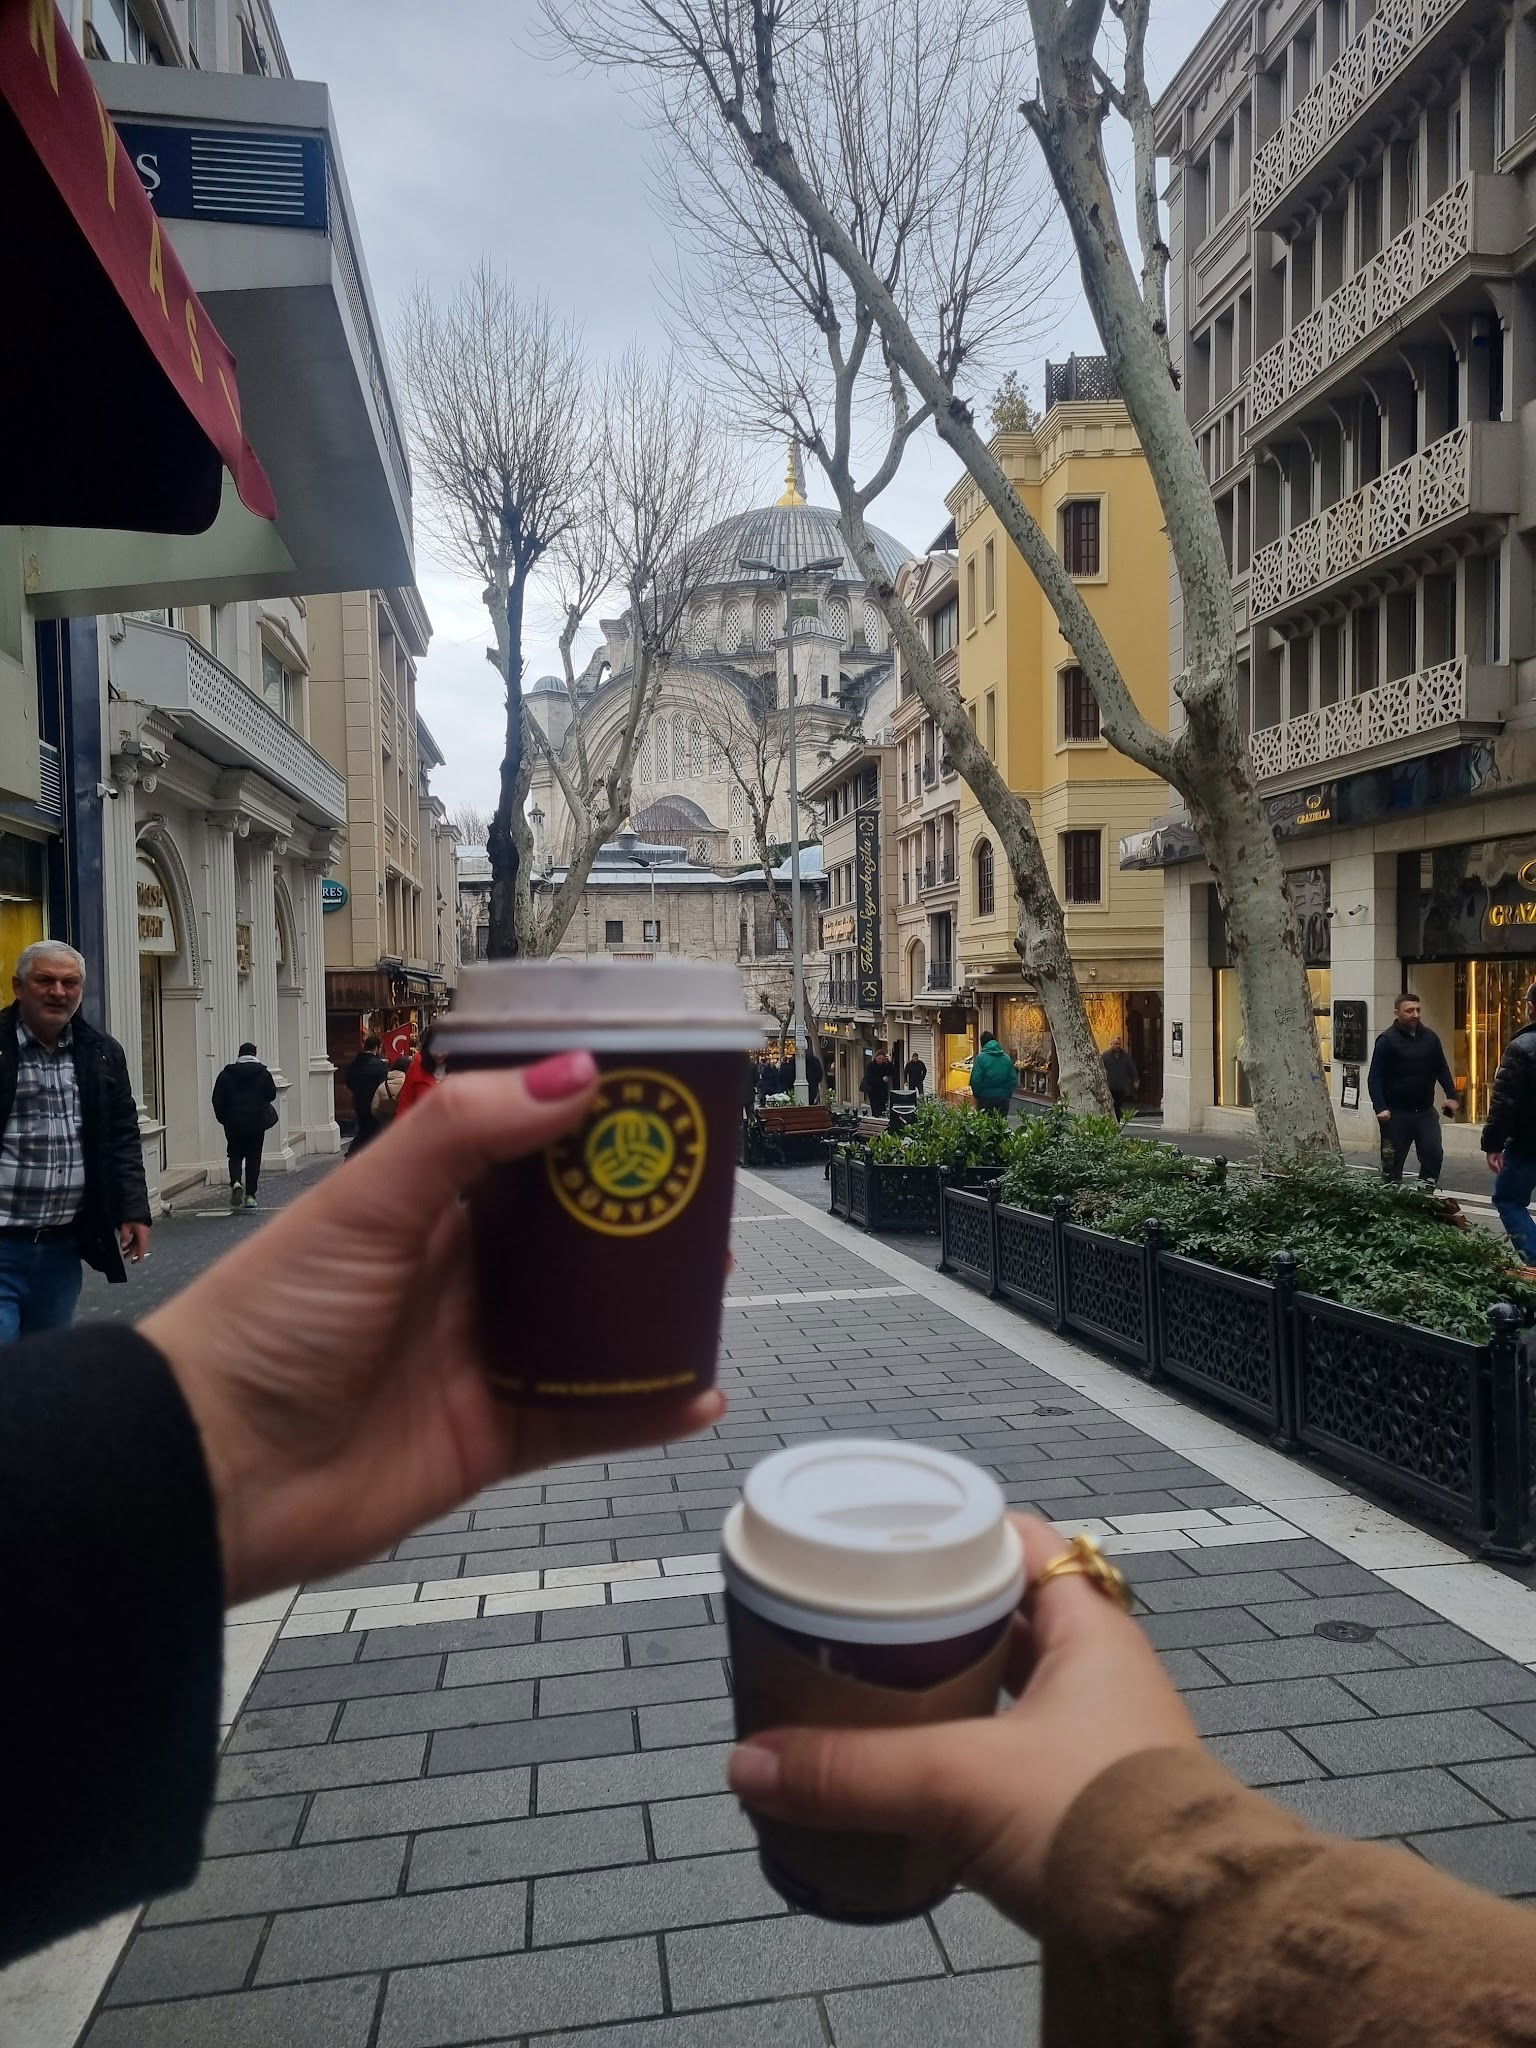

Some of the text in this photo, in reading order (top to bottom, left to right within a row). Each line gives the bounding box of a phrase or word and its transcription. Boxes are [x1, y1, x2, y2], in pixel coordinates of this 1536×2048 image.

[322, 887, 343, 897] RES
[860, 838, 876, 974] Tekin Seyrekoğlu
